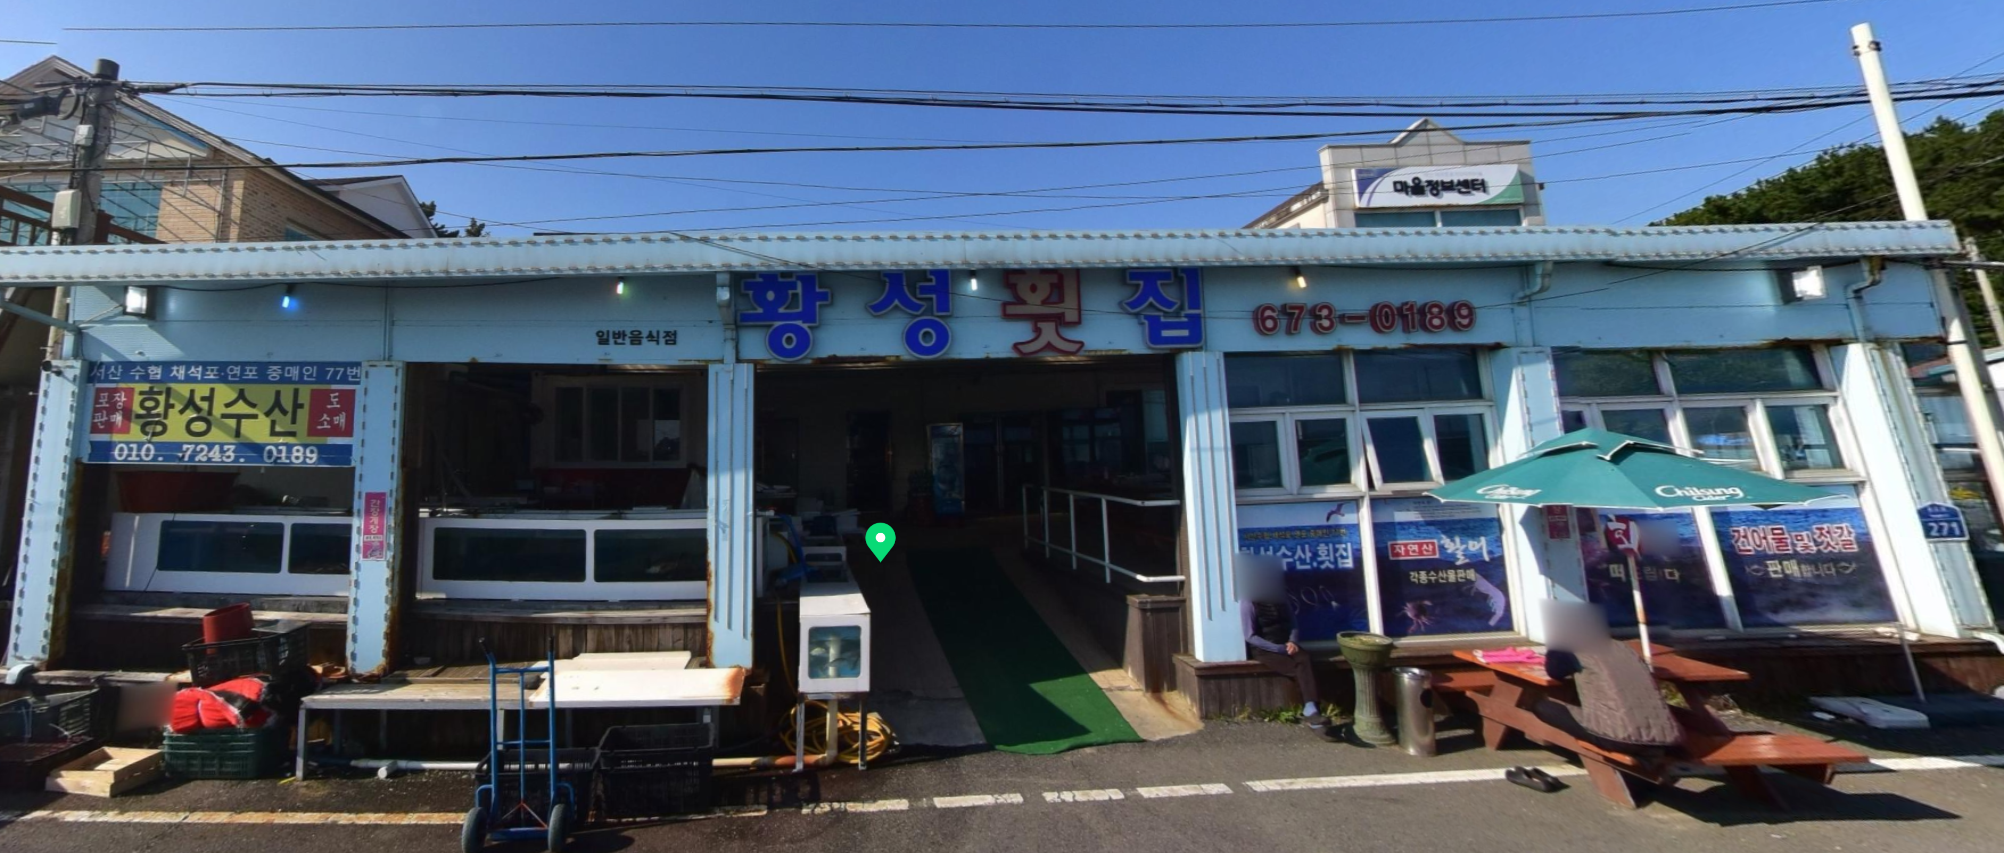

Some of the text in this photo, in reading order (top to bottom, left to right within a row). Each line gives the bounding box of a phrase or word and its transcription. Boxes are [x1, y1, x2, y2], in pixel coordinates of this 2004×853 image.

[1393, 176, 1487, 197] 마을정보센터
[1252, 300, 1476, 336] 673-0189
[595, 329, 677, 346] 일반음식점
[90, 364, 123, 380] 서산
[129, 365, 162, 380] 수협
[266, 365, 317, 381] 중매인
[325, 366, 361, 381] 77번
[95, 390, 127, 410] 포장
[326, 392, 341, 408] 도
[93, 410, 123, 429] 판매
[134, 385, 305, 439] 황성수산
[316, 411, 347, 432] 소매
[263, 445, 318, 464] 0189
[1655, 485, 1745, 499] Chilsung
[1927, 521, 1960, 537] 271
[1731, 523, 1859, 555] 건어물 및 젓갈
[1393, 534, 1490, 566] 자연산 활어
